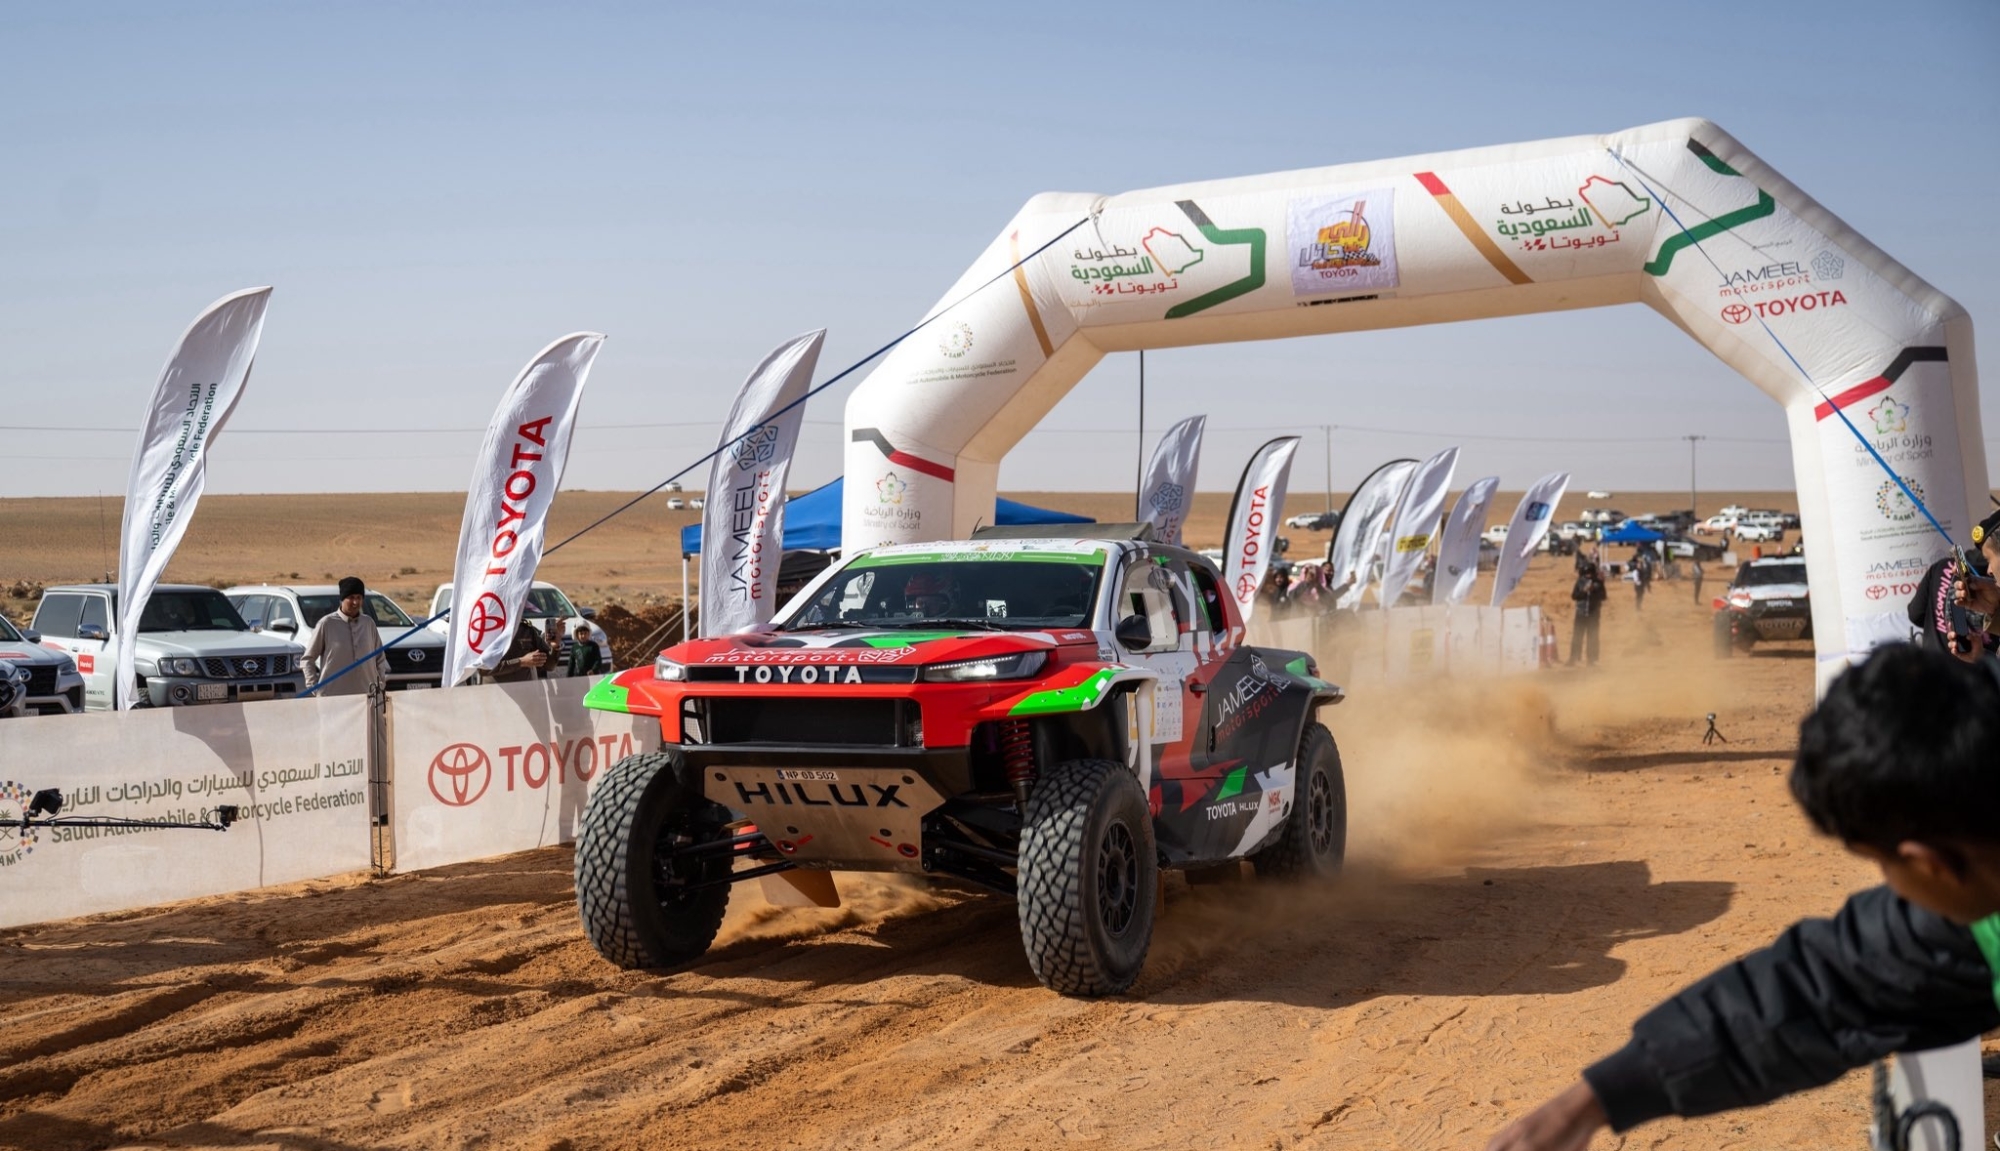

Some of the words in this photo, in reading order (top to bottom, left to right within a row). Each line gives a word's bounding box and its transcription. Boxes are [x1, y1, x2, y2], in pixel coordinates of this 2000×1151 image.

[1500, 197, 1574, 216] بطولة
[1497, 207, 1593, 240] السعودية
[1074, 245, 1138, 262] بطولة
[1550, 230, 1620, 250] تويوتا
[1071, 256, 1154, 284] السعودية
[1319, 268, 1359, 280] TOYOTA
[1718, 261, 1809, 288] JAMEEL
[1117, 278, 1178, 295] تويوتا
[1754, 290, 1848, 319] TOYOTA
[193, 383, 218, 446] Federation
[1905, 449, 1933, 461] Sport
[482, 415, 554, 586] TOYOTA
[896, 507, 921, 521] وزارة
[730, 473, 757, 601] JAMEEL
[898, 520, 921, 530] Sport
[1241, 485, 1269, 570] TOYOTA
[1866, 558, 1928, 574] JAMEEL
[1765, 600, 1794, 608] TOYOTA
[734, 665, 863, 684] TOYOTA
[1215, 674, 1267, 729] JAMEEL
[323, 758, 364, 780] الاتحاد
[498, 732, 636, 792] TOYOTA
[785, 771, 799, 779] NP
[815, 771, 837, 780] 502
[106, 778, 183, 805] والدراجات
[187, 769, 254, 797] للسيارات
[257, 763, 321, 793] السعودي
[61, 786, 101, 813] الناري
[733, 781, 911, 808] HILUX
[103, 807, 196, 838] Automobile
[295, 788, 365, 813] Federation
[1205, 801, 1237, 821] TOYOTA
